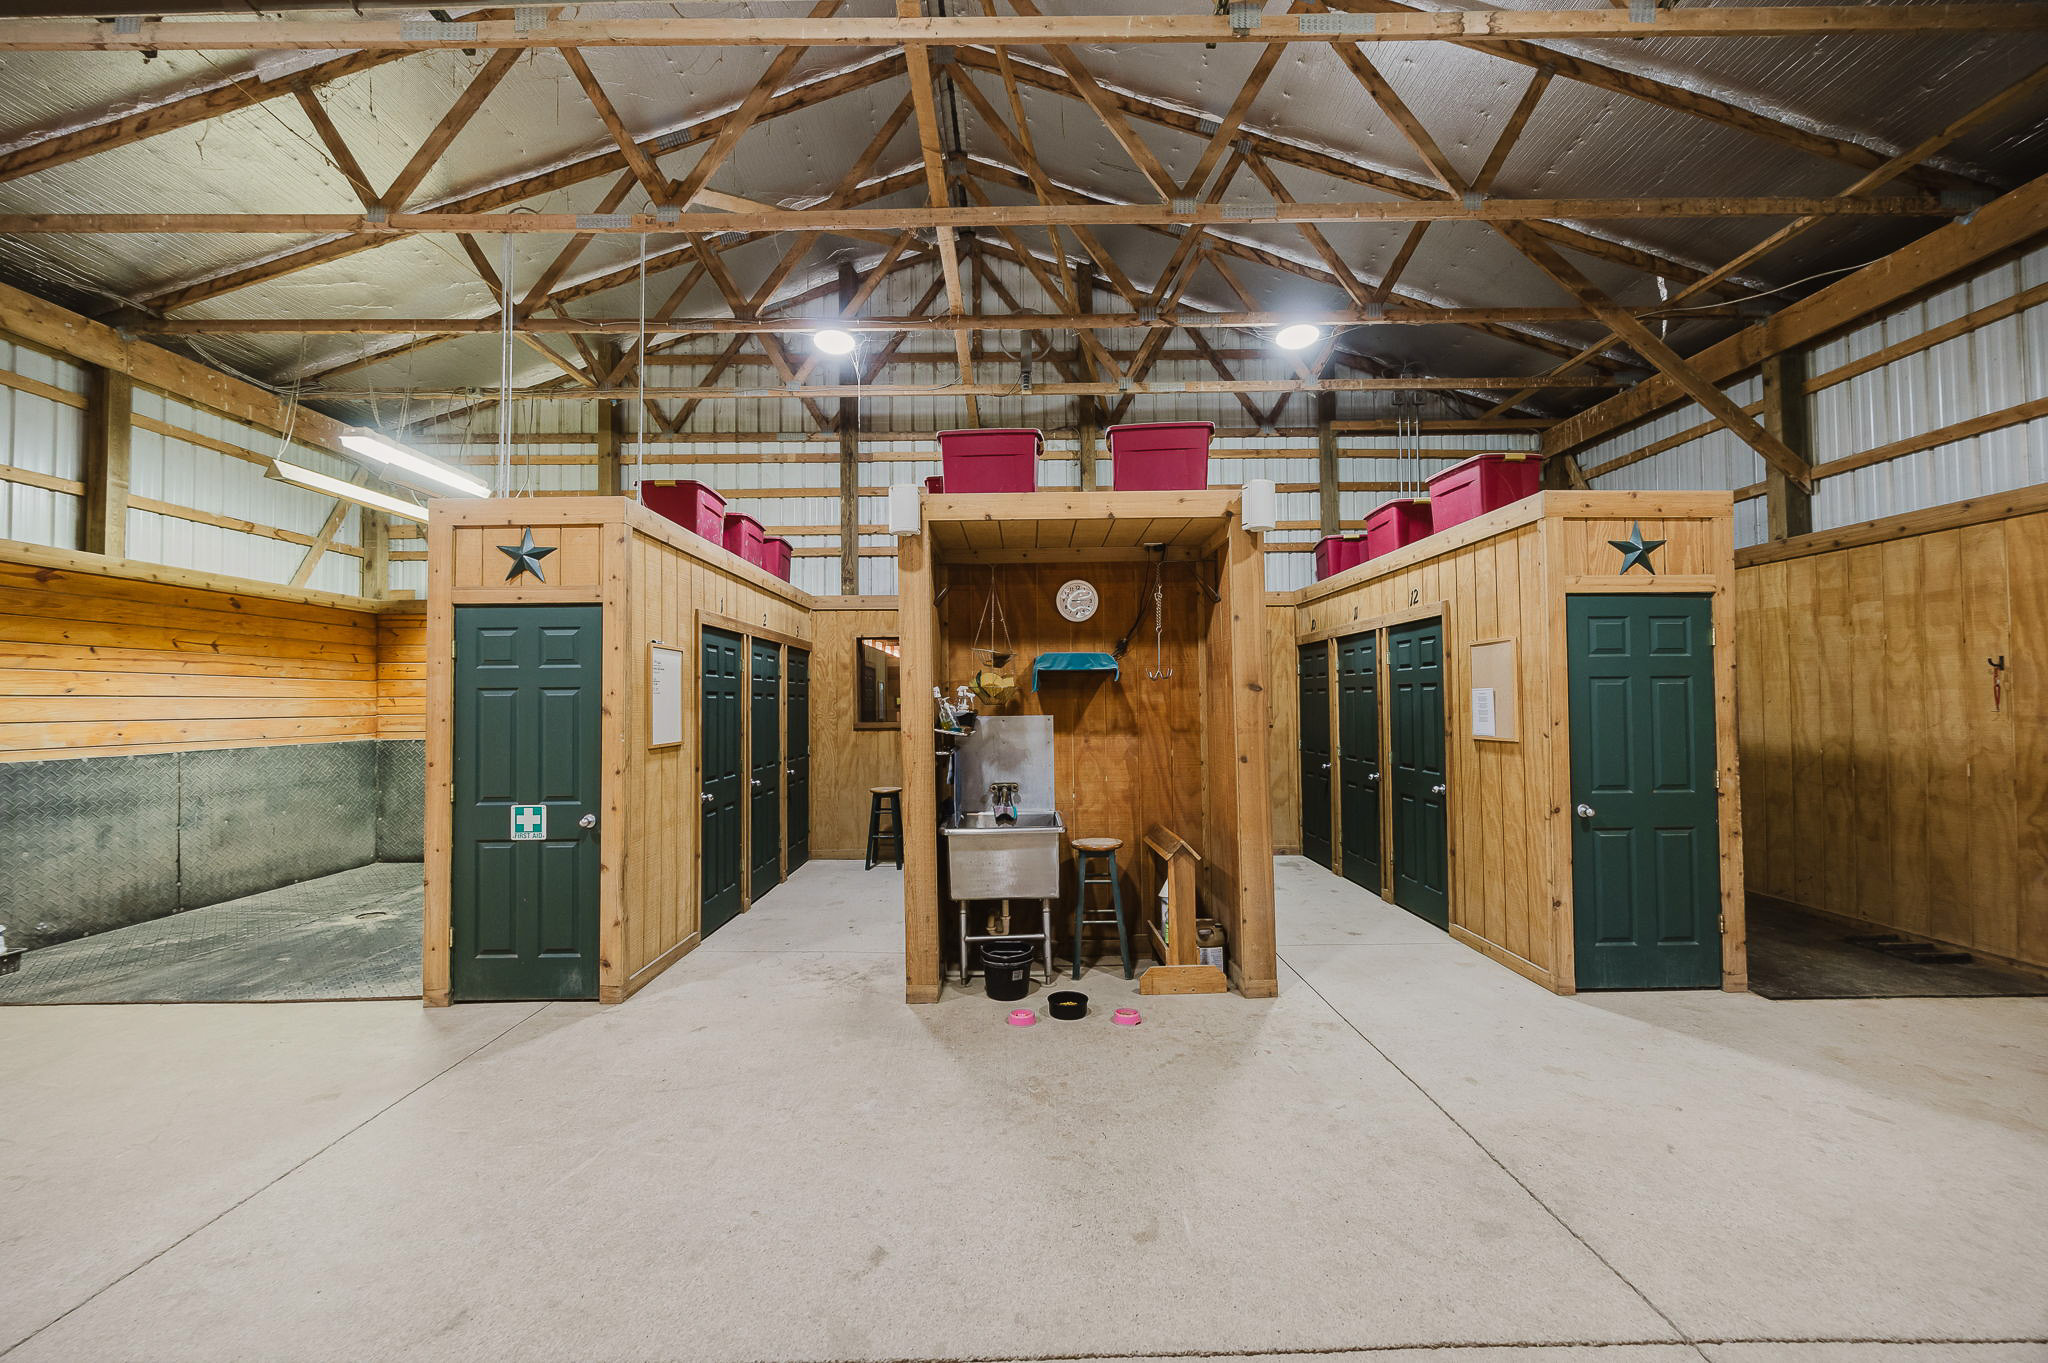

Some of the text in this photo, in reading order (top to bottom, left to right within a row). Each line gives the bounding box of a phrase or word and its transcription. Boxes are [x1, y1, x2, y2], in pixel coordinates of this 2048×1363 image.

[1409, 588, 1419, 607] 12
[762, 613, 767, 627] 2
[1353, 606, 1359, 621] 11
